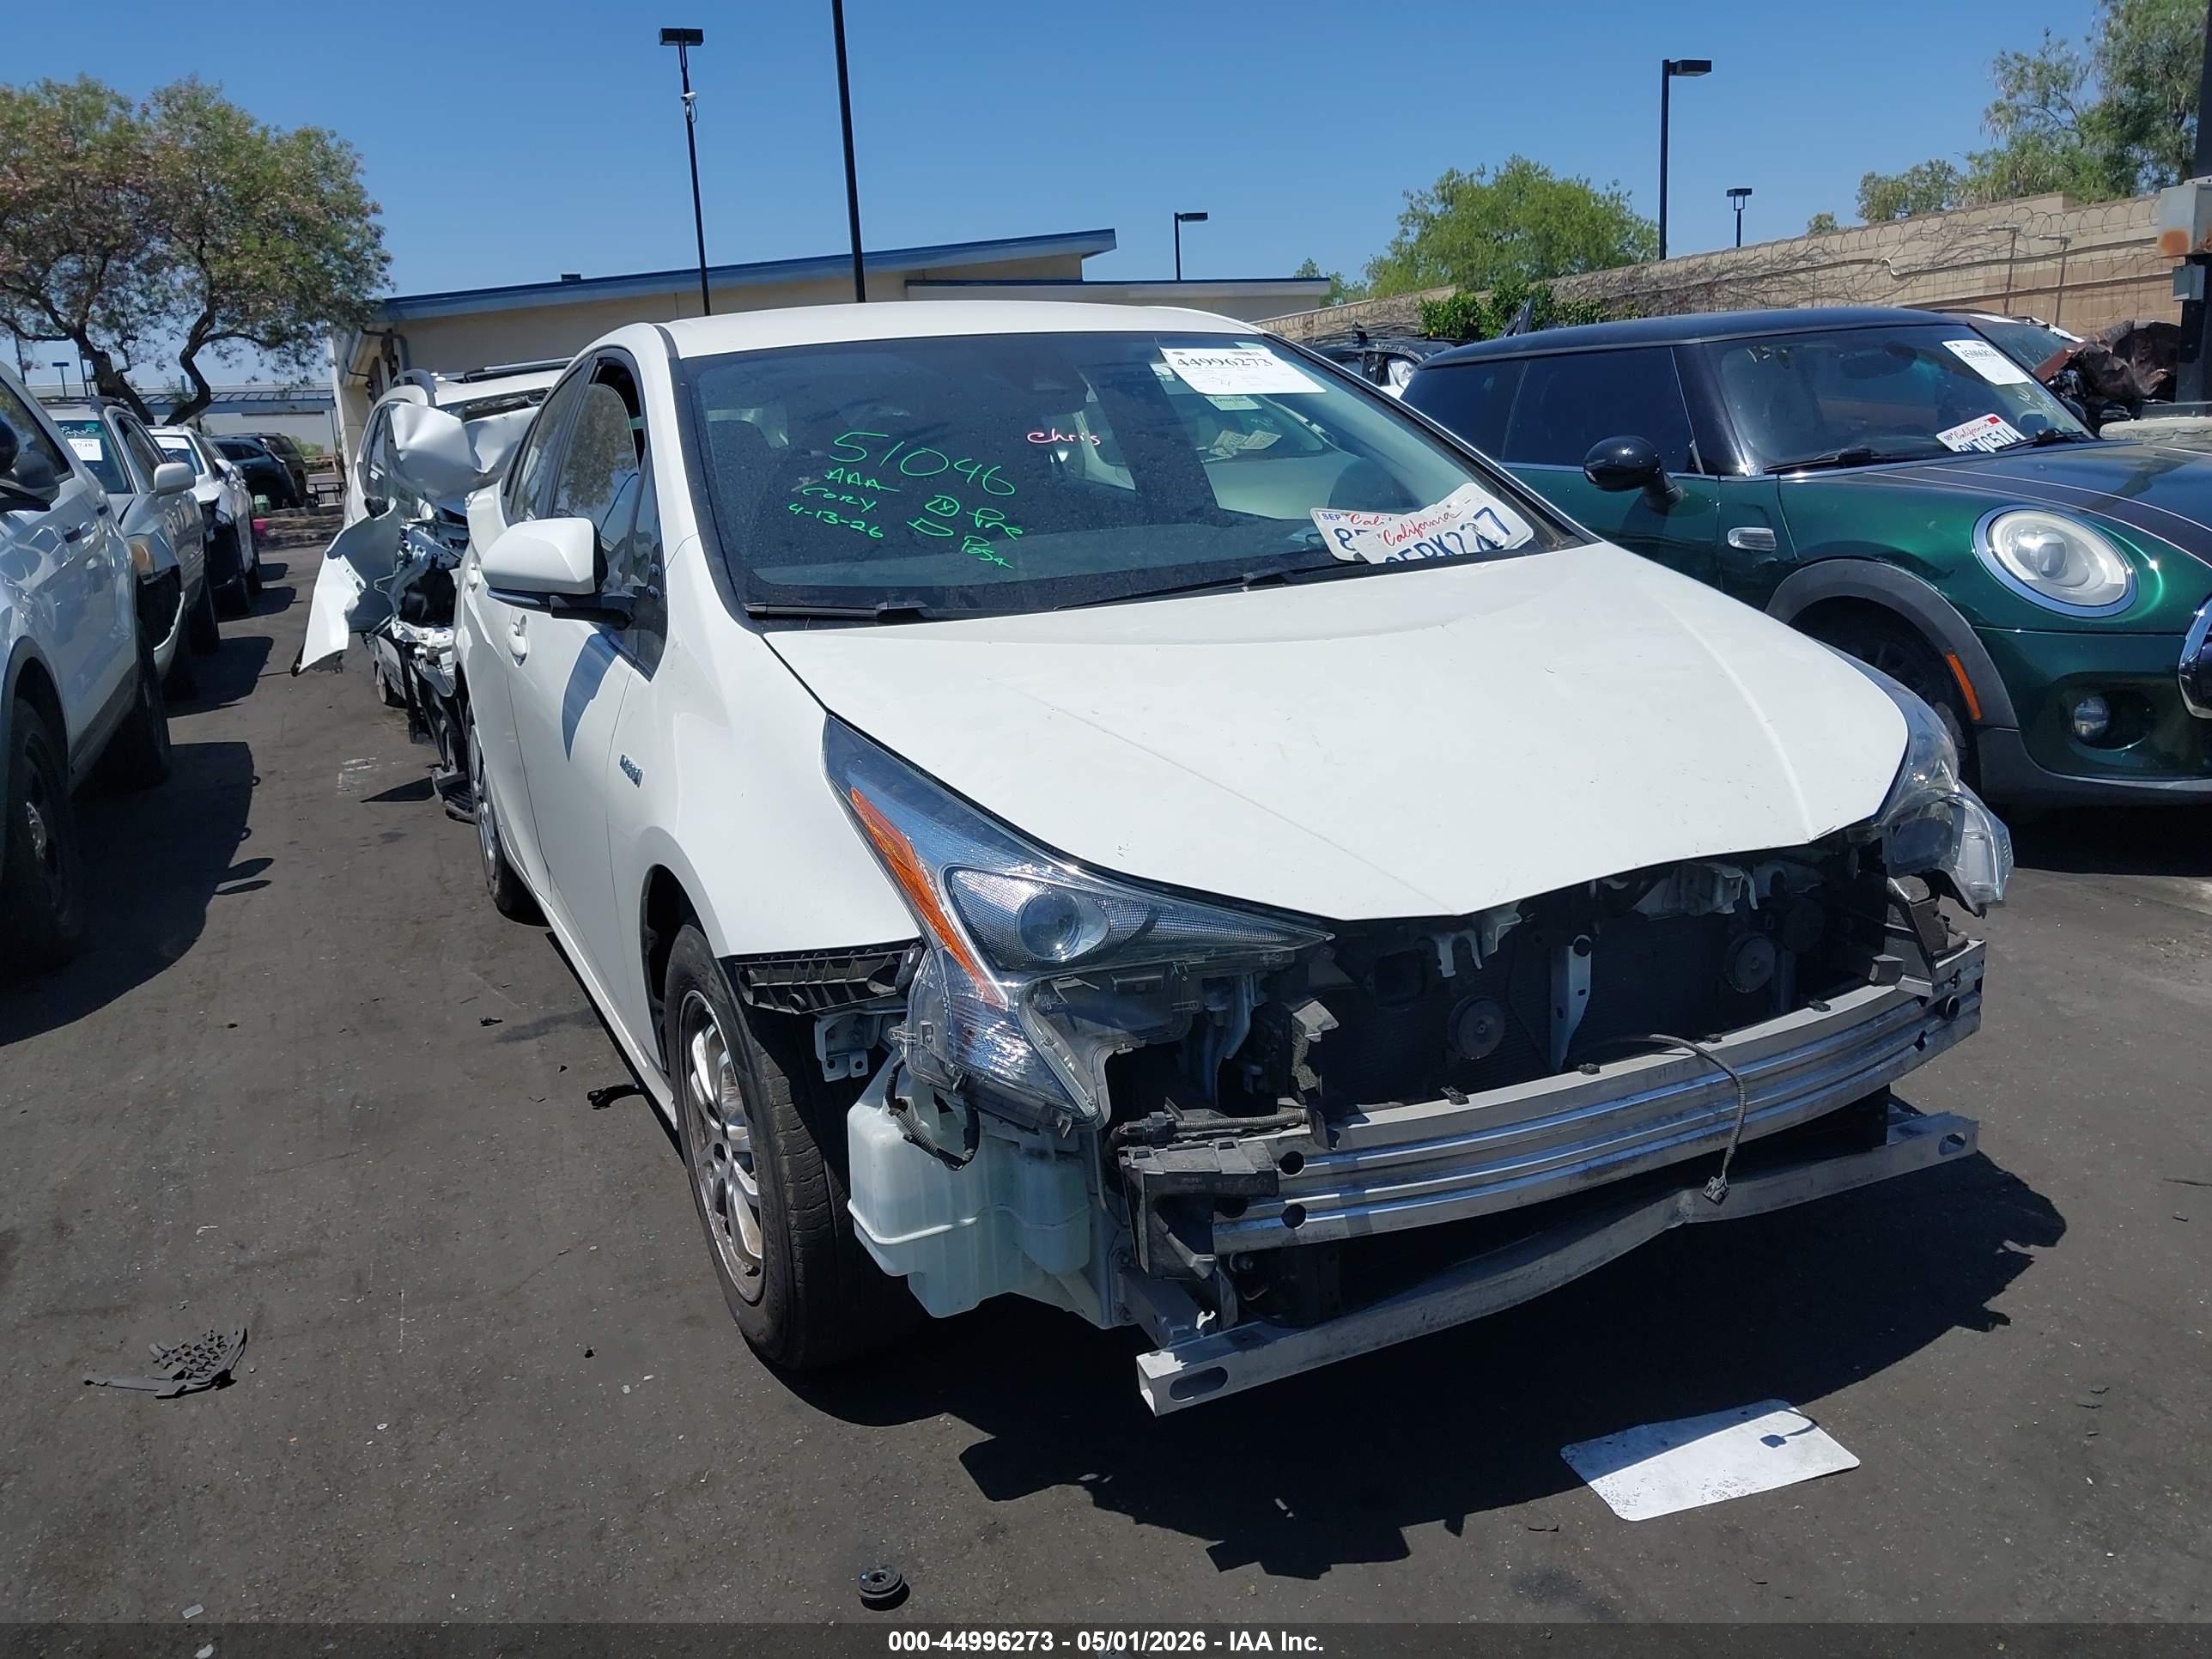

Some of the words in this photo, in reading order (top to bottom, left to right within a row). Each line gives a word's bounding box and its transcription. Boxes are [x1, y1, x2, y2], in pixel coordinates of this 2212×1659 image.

[1176, 357, 1273, 367] 44996273
[829, 431, 1016, 495] 51046
[824, 467, 901, 492] AAA
[1322, 513, 1341, 521] SEP
[1382, 508, 1463, 547] California
